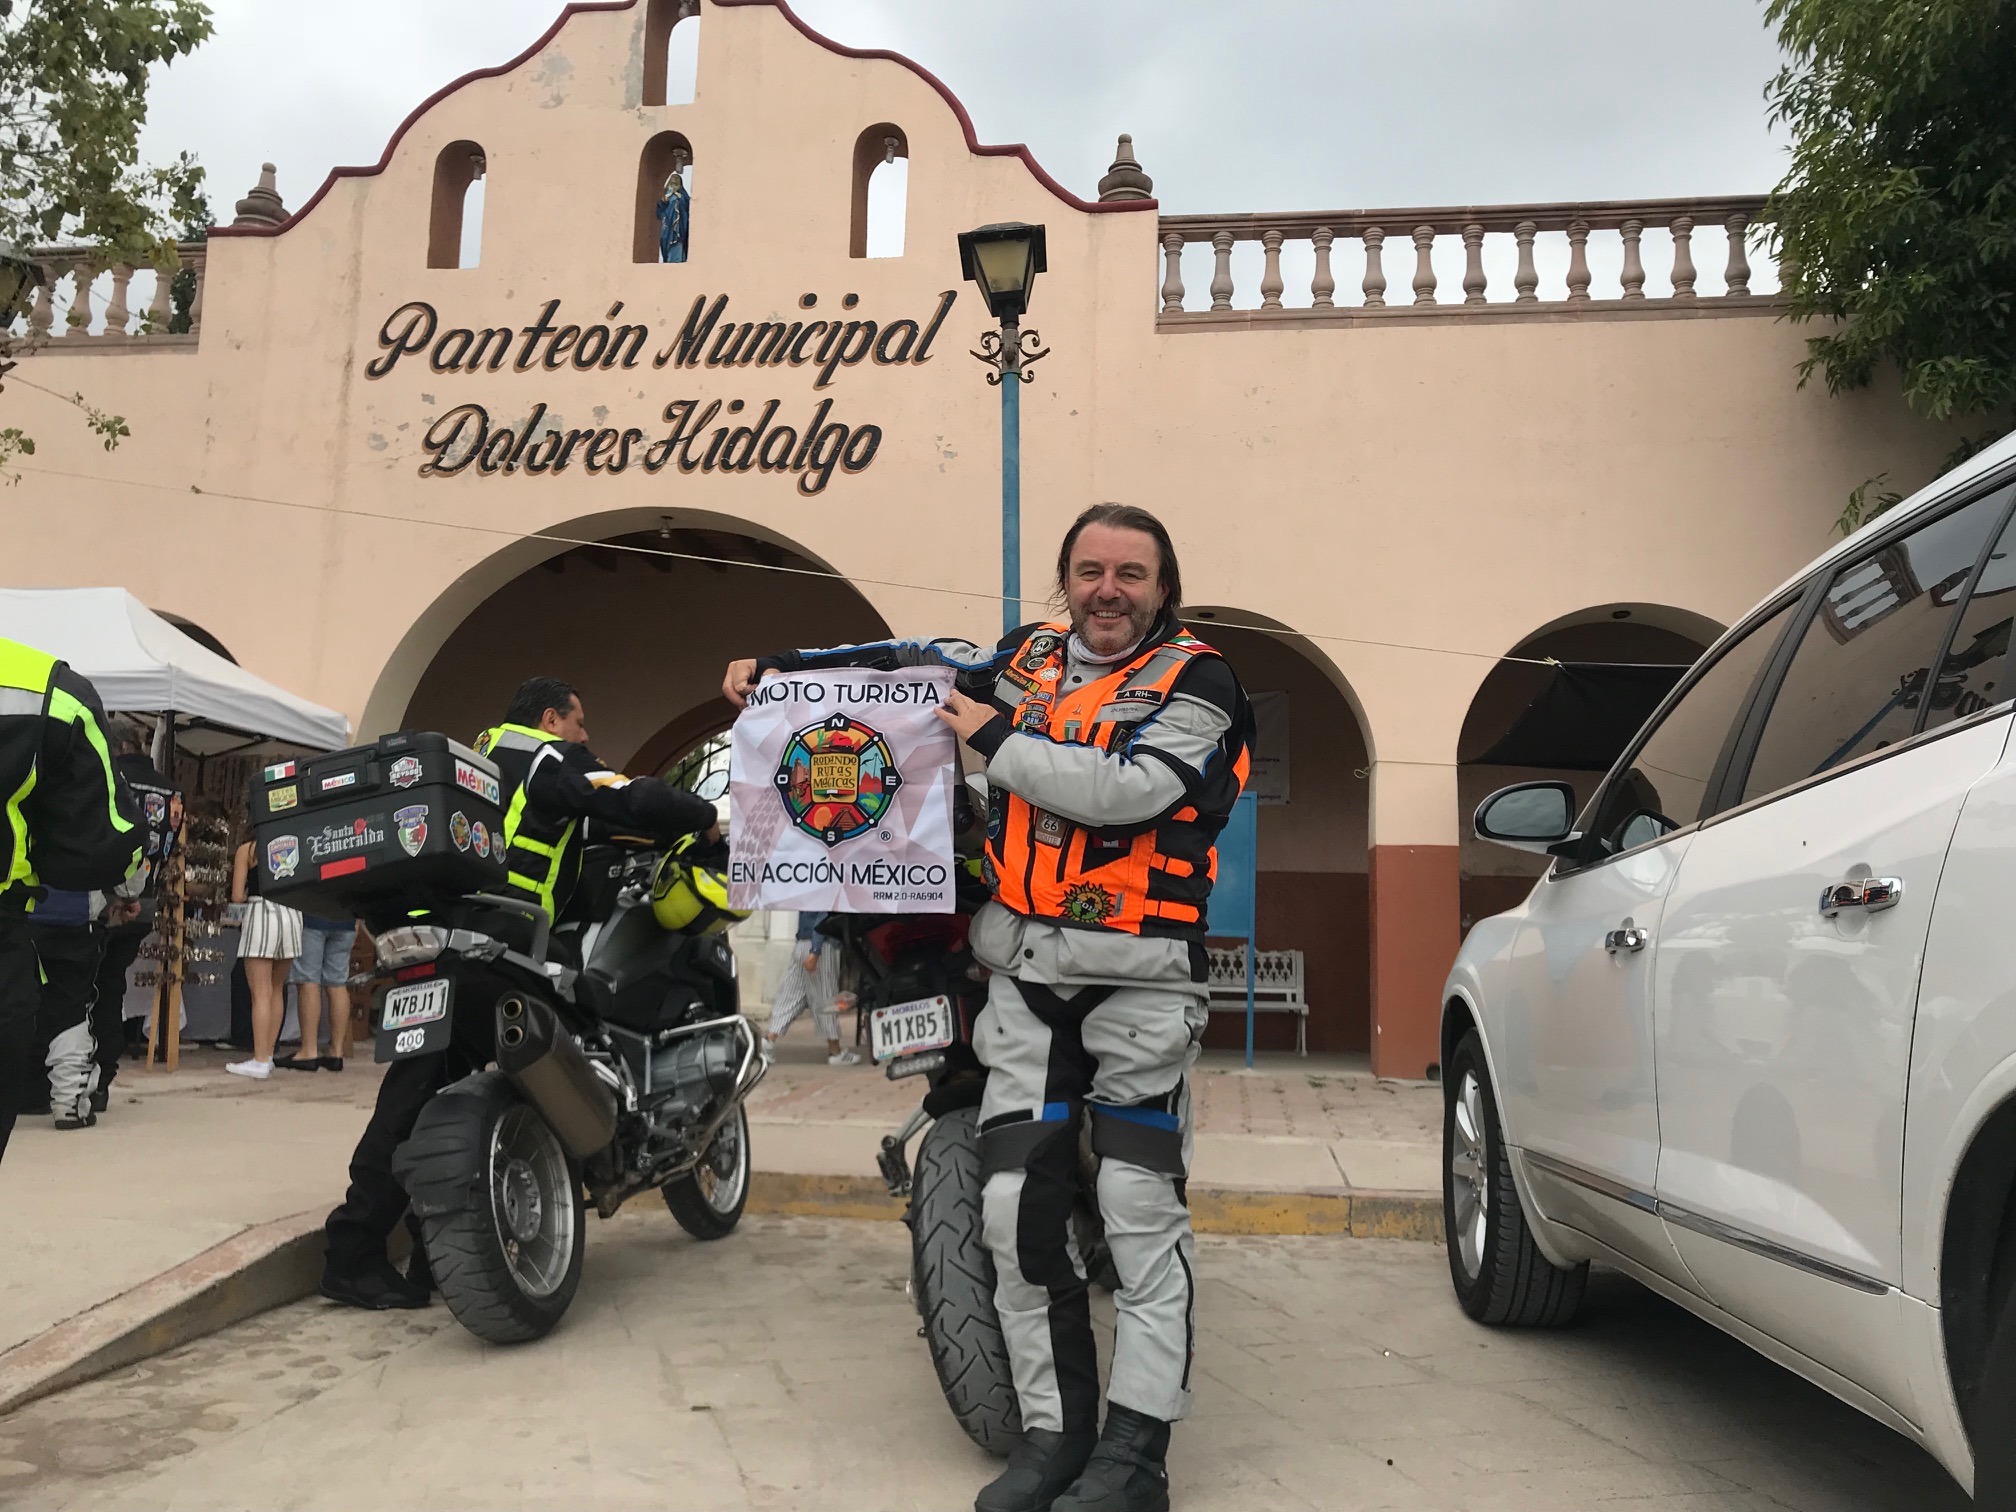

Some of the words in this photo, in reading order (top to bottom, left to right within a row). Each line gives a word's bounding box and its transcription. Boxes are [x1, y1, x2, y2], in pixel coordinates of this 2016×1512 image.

[365, 298, 648, 379] Panteón
[653, 290, 957, 389] Municipal
[418, 402, 643, 476] Dolores
[643, 398, 882, 496] Hidalgo
[750, 681, 826, 706] MOTO
[834, 682, 940, 704] TURISTA
[831, 718, 845, 727] N
[886, 776, 897, 786] E
[322, 825, 354, 841] Santa
[1043, 818, 1058, 831] 66
[306, 828, 385, 863] Esmeralda
[827, 831, 836, 841] S
[732, 863, 756, 883] EN
[761, 857, 844, 884] ACCIÓN
[852, 859, 947, 886] MÉXICO
[873, 891, 893, 901] RRM
[391, 992, 434, 1018] N7BJ1
[881, 1011, 938, 1047] M1XB5
[397, 1032, 423, 1048] 400
